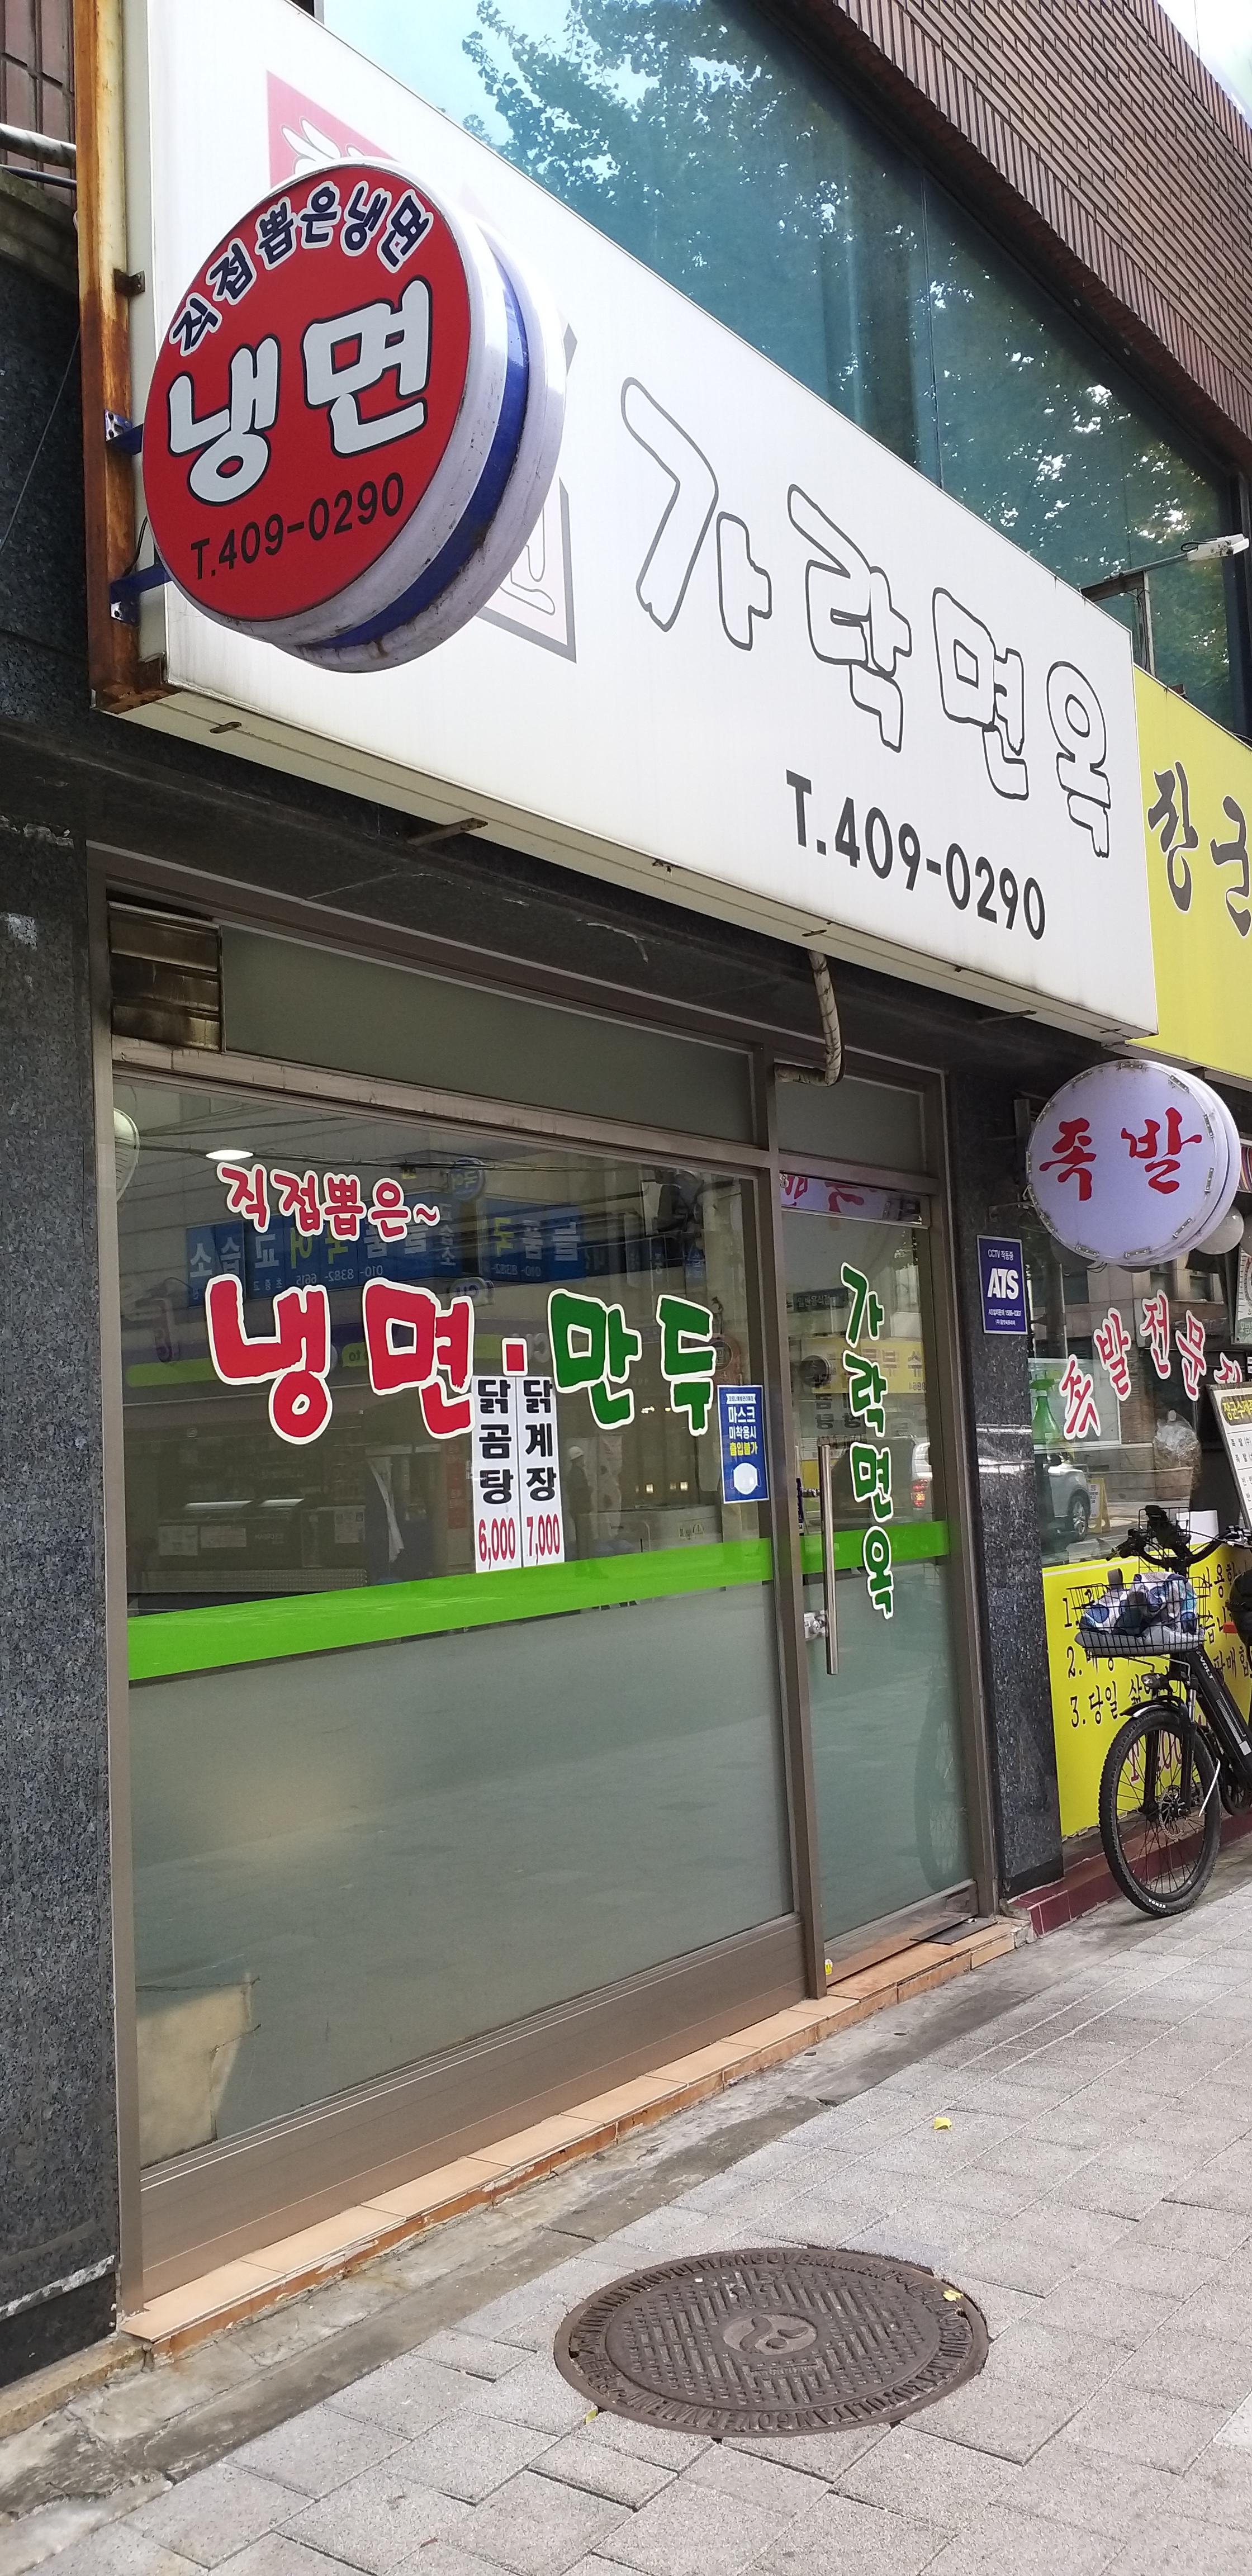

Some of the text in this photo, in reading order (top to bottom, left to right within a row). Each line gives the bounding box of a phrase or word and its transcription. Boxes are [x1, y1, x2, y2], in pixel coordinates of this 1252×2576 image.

[167, 275, 433, 506] 냉면
[191, 472, 404, 580] T.409-0290
[621, 376, 1111, 859] 가락면옥
[785, 770, 1045, 940] T.409-0290
[1039, 1106, 1202, 1201] 족발
[987, 1268, 1019, 1300] ATS
[548, 1289, 717, 1436] 만두
[728, 1406, 756, 1423] 마스크
[478, 1379, 514, 1504] 닭곰탕
[523, 1379, 557, 1502] 닭계장
[729, 1426, 757, 1440] 미착용시
[729, 1441, 758, 1456] 출입불가
[841, 1262, 894, 1620] 가락면옥
[478, 1517, 515, 1570] 6,000
[527, 1513, 560, 1565] 7,000
